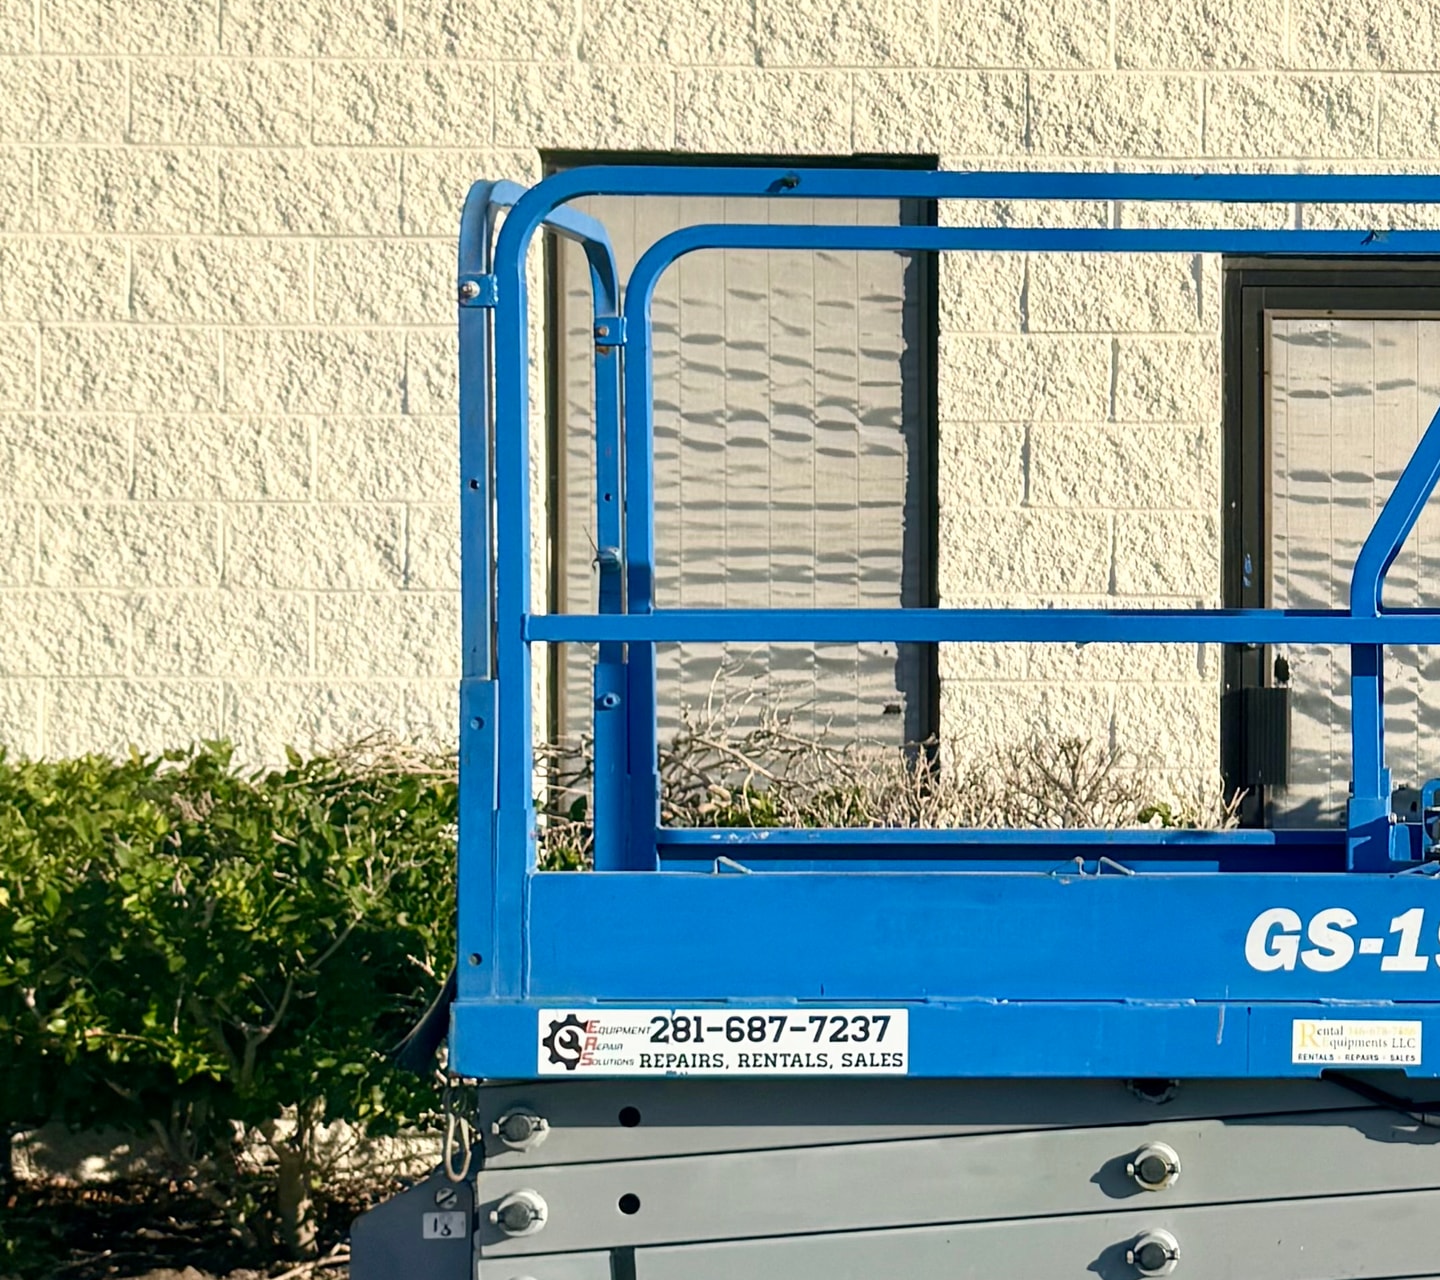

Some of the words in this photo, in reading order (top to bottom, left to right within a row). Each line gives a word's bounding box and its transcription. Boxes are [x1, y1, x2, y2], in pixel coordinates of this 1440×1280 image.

[650, 1015, 891, 1044] 281-687-7237
[1392, 1037, 1417, 1049] LLC
[639, 1053, 729, 1069] REPAIRS,
[737, 1053, 833, 1069] RENTALS,
[842, 1052, 903, 1068] SALES
